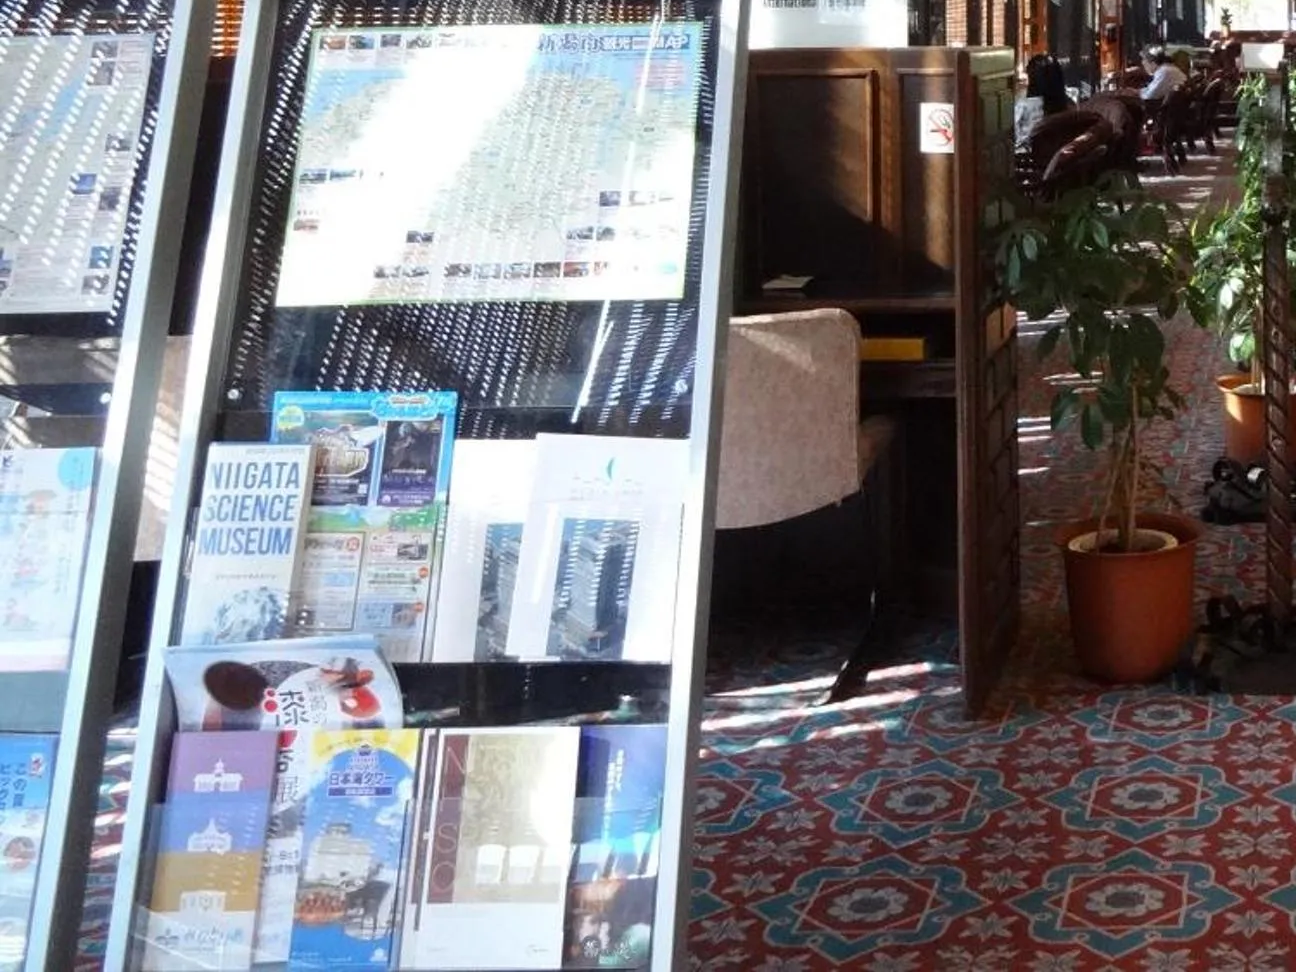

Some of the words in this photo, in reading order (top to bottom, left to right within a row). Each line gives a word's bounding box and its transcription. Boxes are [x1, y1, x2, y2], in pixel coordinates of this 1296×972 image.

[210, 461, 300, 490] NIIGATA
[203, 494, 298, 522] SCIENCE
[199, 527, 292, 555] MUSEUM
